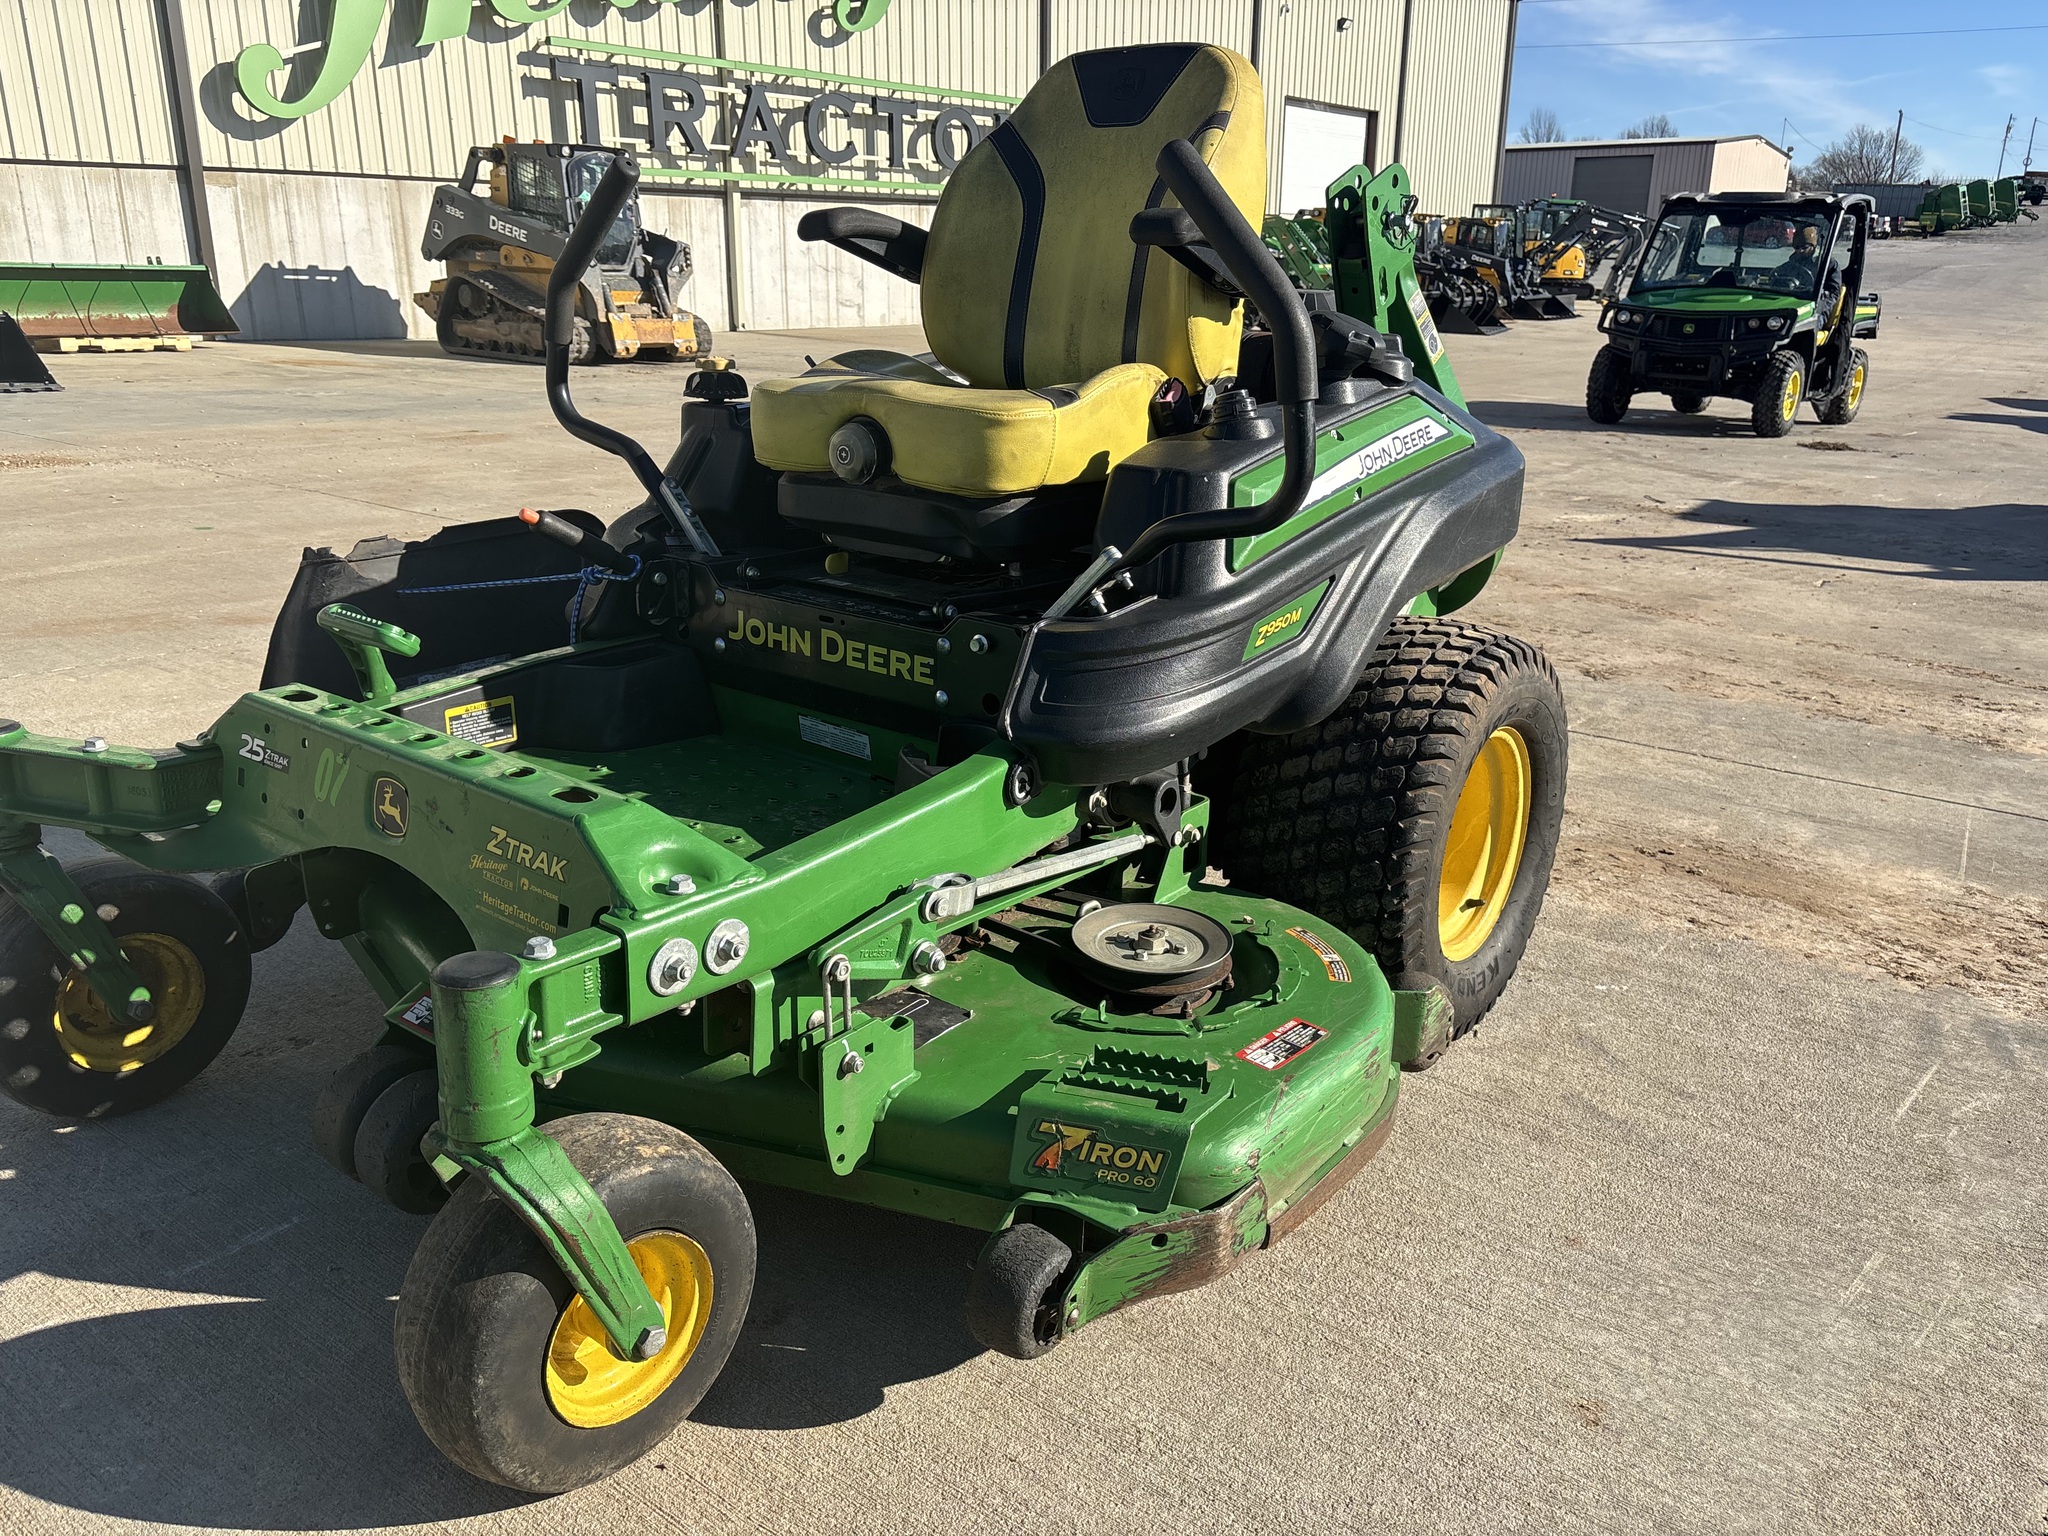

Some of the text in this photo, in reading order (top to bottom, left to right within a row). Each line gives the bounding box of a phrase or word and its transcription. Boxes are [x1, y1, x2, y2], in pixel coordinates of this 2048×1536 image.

[552, 57, 1008, 168] TRACTO
[445, 204, 465, 220] 333G
[489, 214, 528, 243] DEERE
[1358, 424, 1435, 477] JOHN DEERE
[1254, 606, 1303, 648] Z950M
[728, 609, 935, 686] JOHN DEERE
[470, 702, 492, 711] CAUTION
[238, 733, 266, 762] 25
[469, 854, 509, 873] Heritage
[485, 825, 568, 882] ZTRAK
[483, 870, 515, 890] TRACTOR
[529, 884, 560, 901] JOHN DEERE
[481, 890, 558, 935] HeritageTractor.com
[1096, 1168, 1157, 1189] PRO 60
